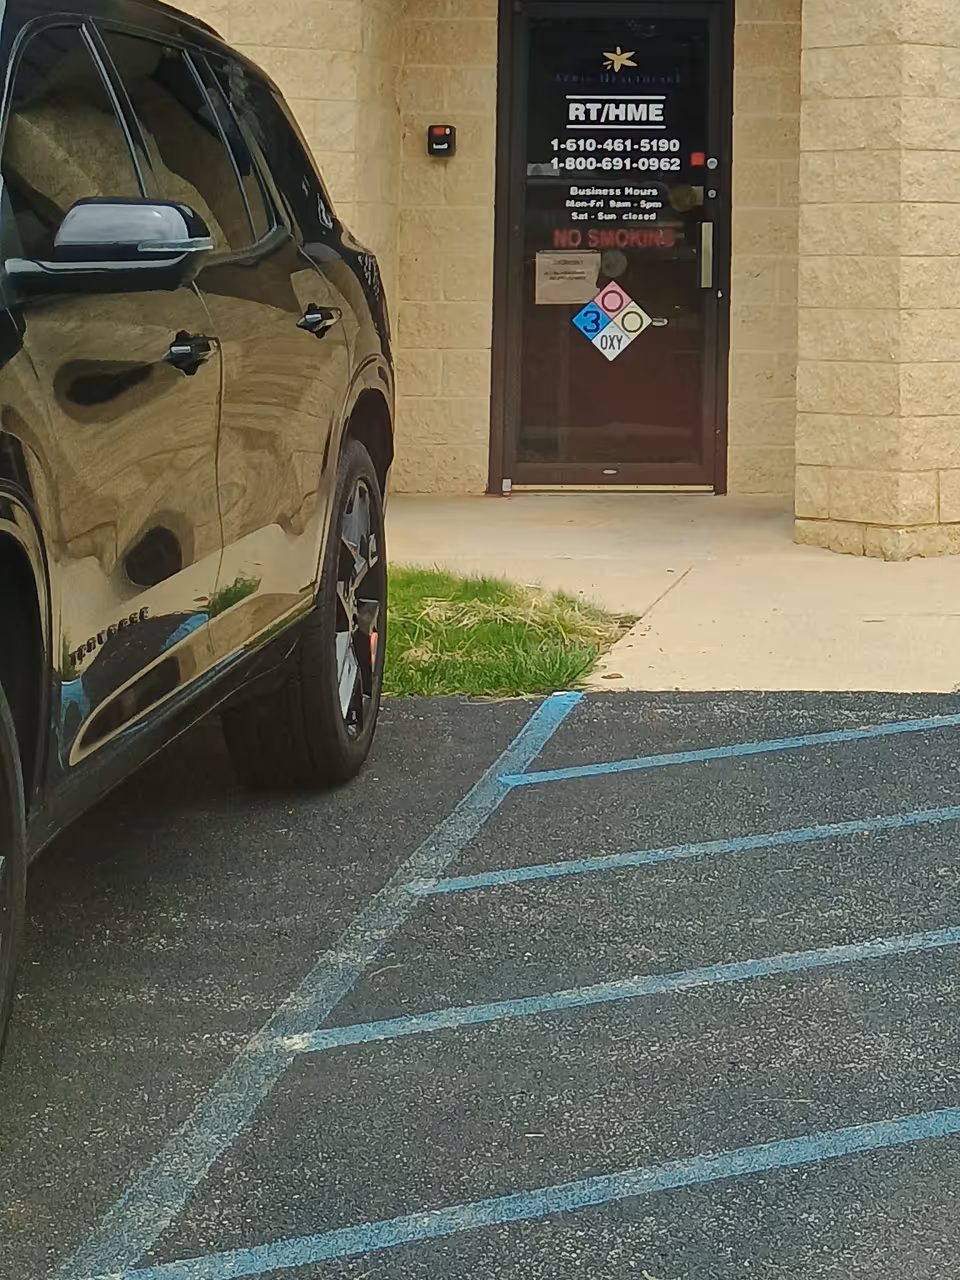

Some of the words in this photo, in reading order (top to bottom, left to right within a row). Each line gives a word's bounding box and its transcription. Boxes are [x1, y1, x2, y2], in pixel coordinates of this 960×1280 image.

[568, 103, 664, 122] RT/HME
[551, 138, 680, 151] 1-610-461-5190
[551, 157, 681, 170] 1-800-691-0962
[570, 187, 621, 196] Business
[624, 187, 658, 196] Hours
[553, 229, 582, 247] NO
[582, 310, 601, 333] 3
[600, 334, 623, 350] OXY
